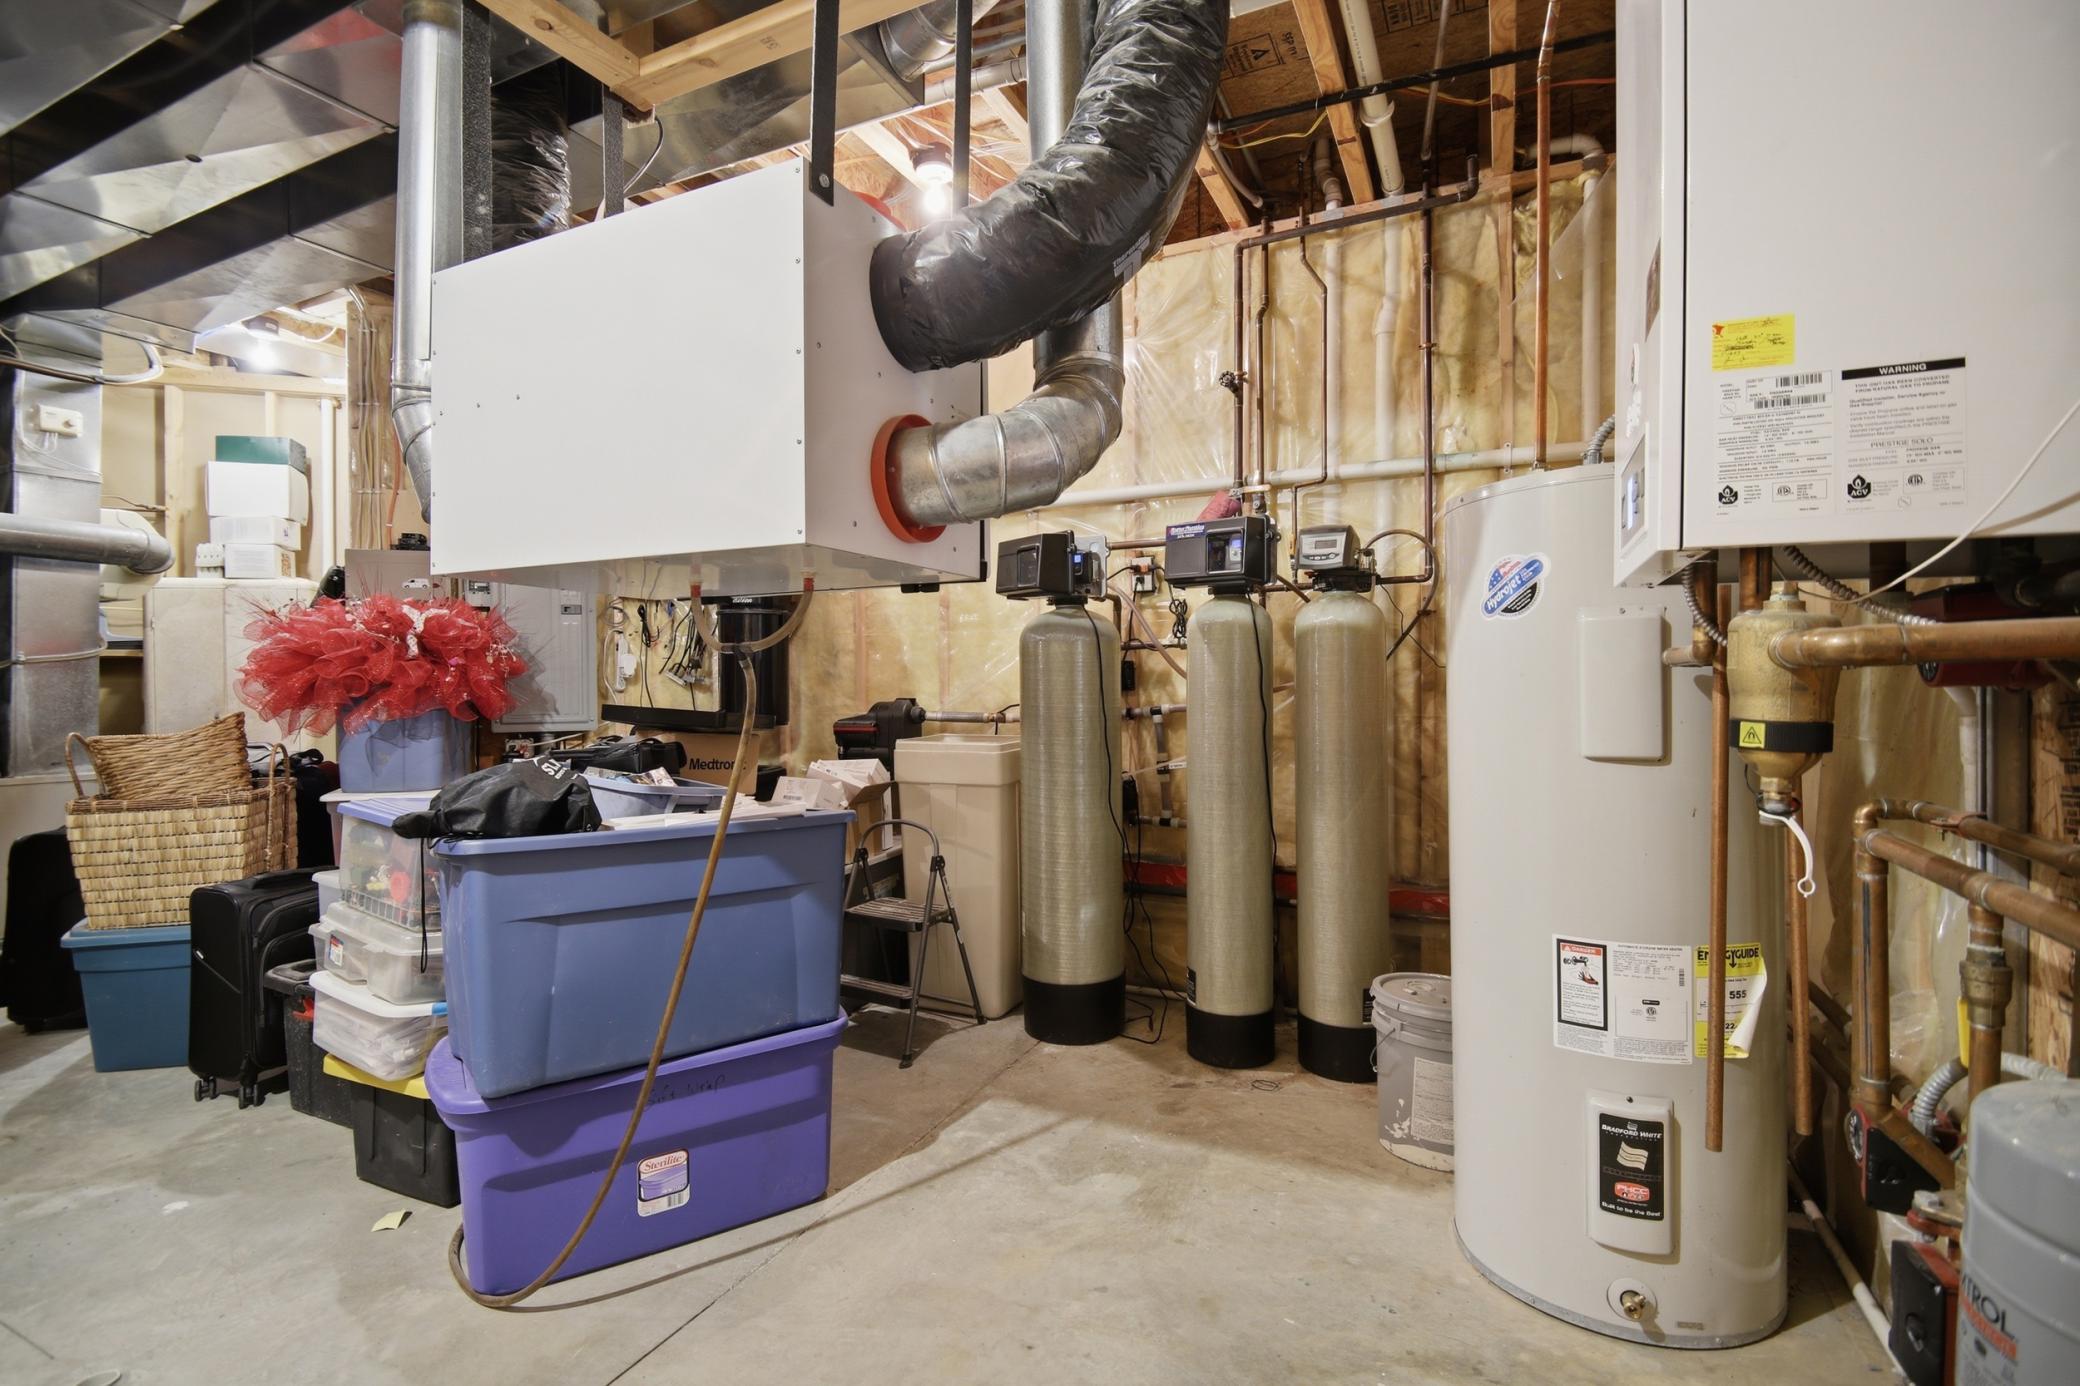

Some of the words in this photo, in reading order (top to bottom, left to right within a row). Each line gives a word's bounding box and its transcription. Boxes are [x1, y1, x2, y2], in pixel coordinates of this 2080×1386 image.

[1879, 363, 1927, 375] WARNING
[1486, 575, 1522, 611] Hydrojet
[689, 758, 746, 770] Medtro
[1697, 947, 1760, 961] ENGYGUIDE
[1729, 990, 1747, 999] 555
[1601, 1124, 1639, 1137] BRADFORD
[1639, 1130, 1663, 1139] WHITE
[644, 1155, 682, 1171] Sterilite
